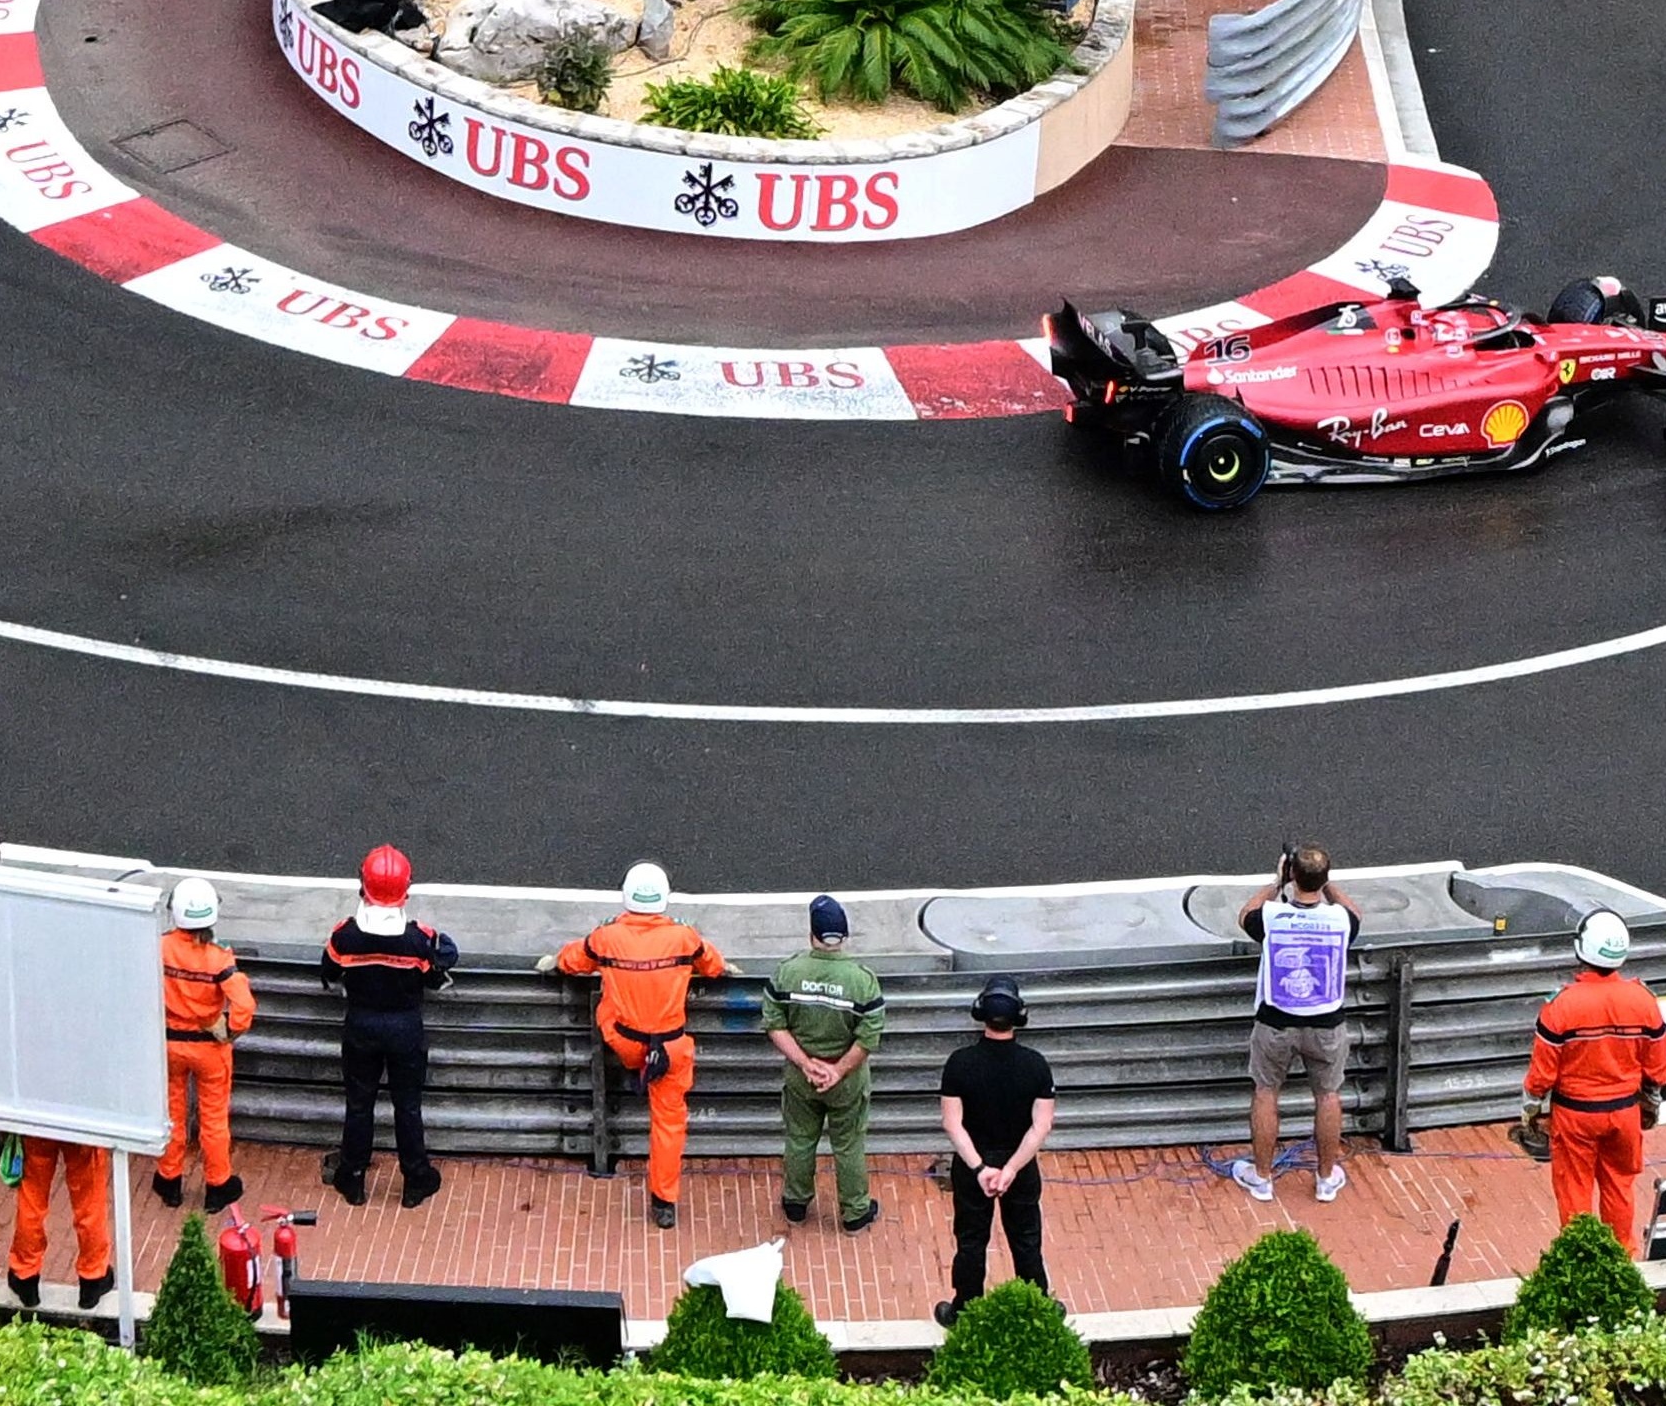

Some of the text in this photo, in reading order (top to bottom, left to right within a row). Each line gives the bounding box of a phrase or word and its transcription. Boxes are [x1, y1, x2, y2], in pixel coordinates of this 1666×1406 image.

[294, 17, 362, 110] UBS
[4, 140, 92, 201] UBS
[463, 118, 591, 202] UBS
[754, 170, 900, 233] UBS
[1380, 213, 1455, 260] UBS
[275, 288, 411, 343] UBS
[1204, 335, 1252, 366] 16
[719, 360, 866, 391] UBS
[1224, 366, 1298, 384] Santander
[1317, 407, 1407, 447] Ray-Ban
[801, 980, 844, 996] DOCTOR
